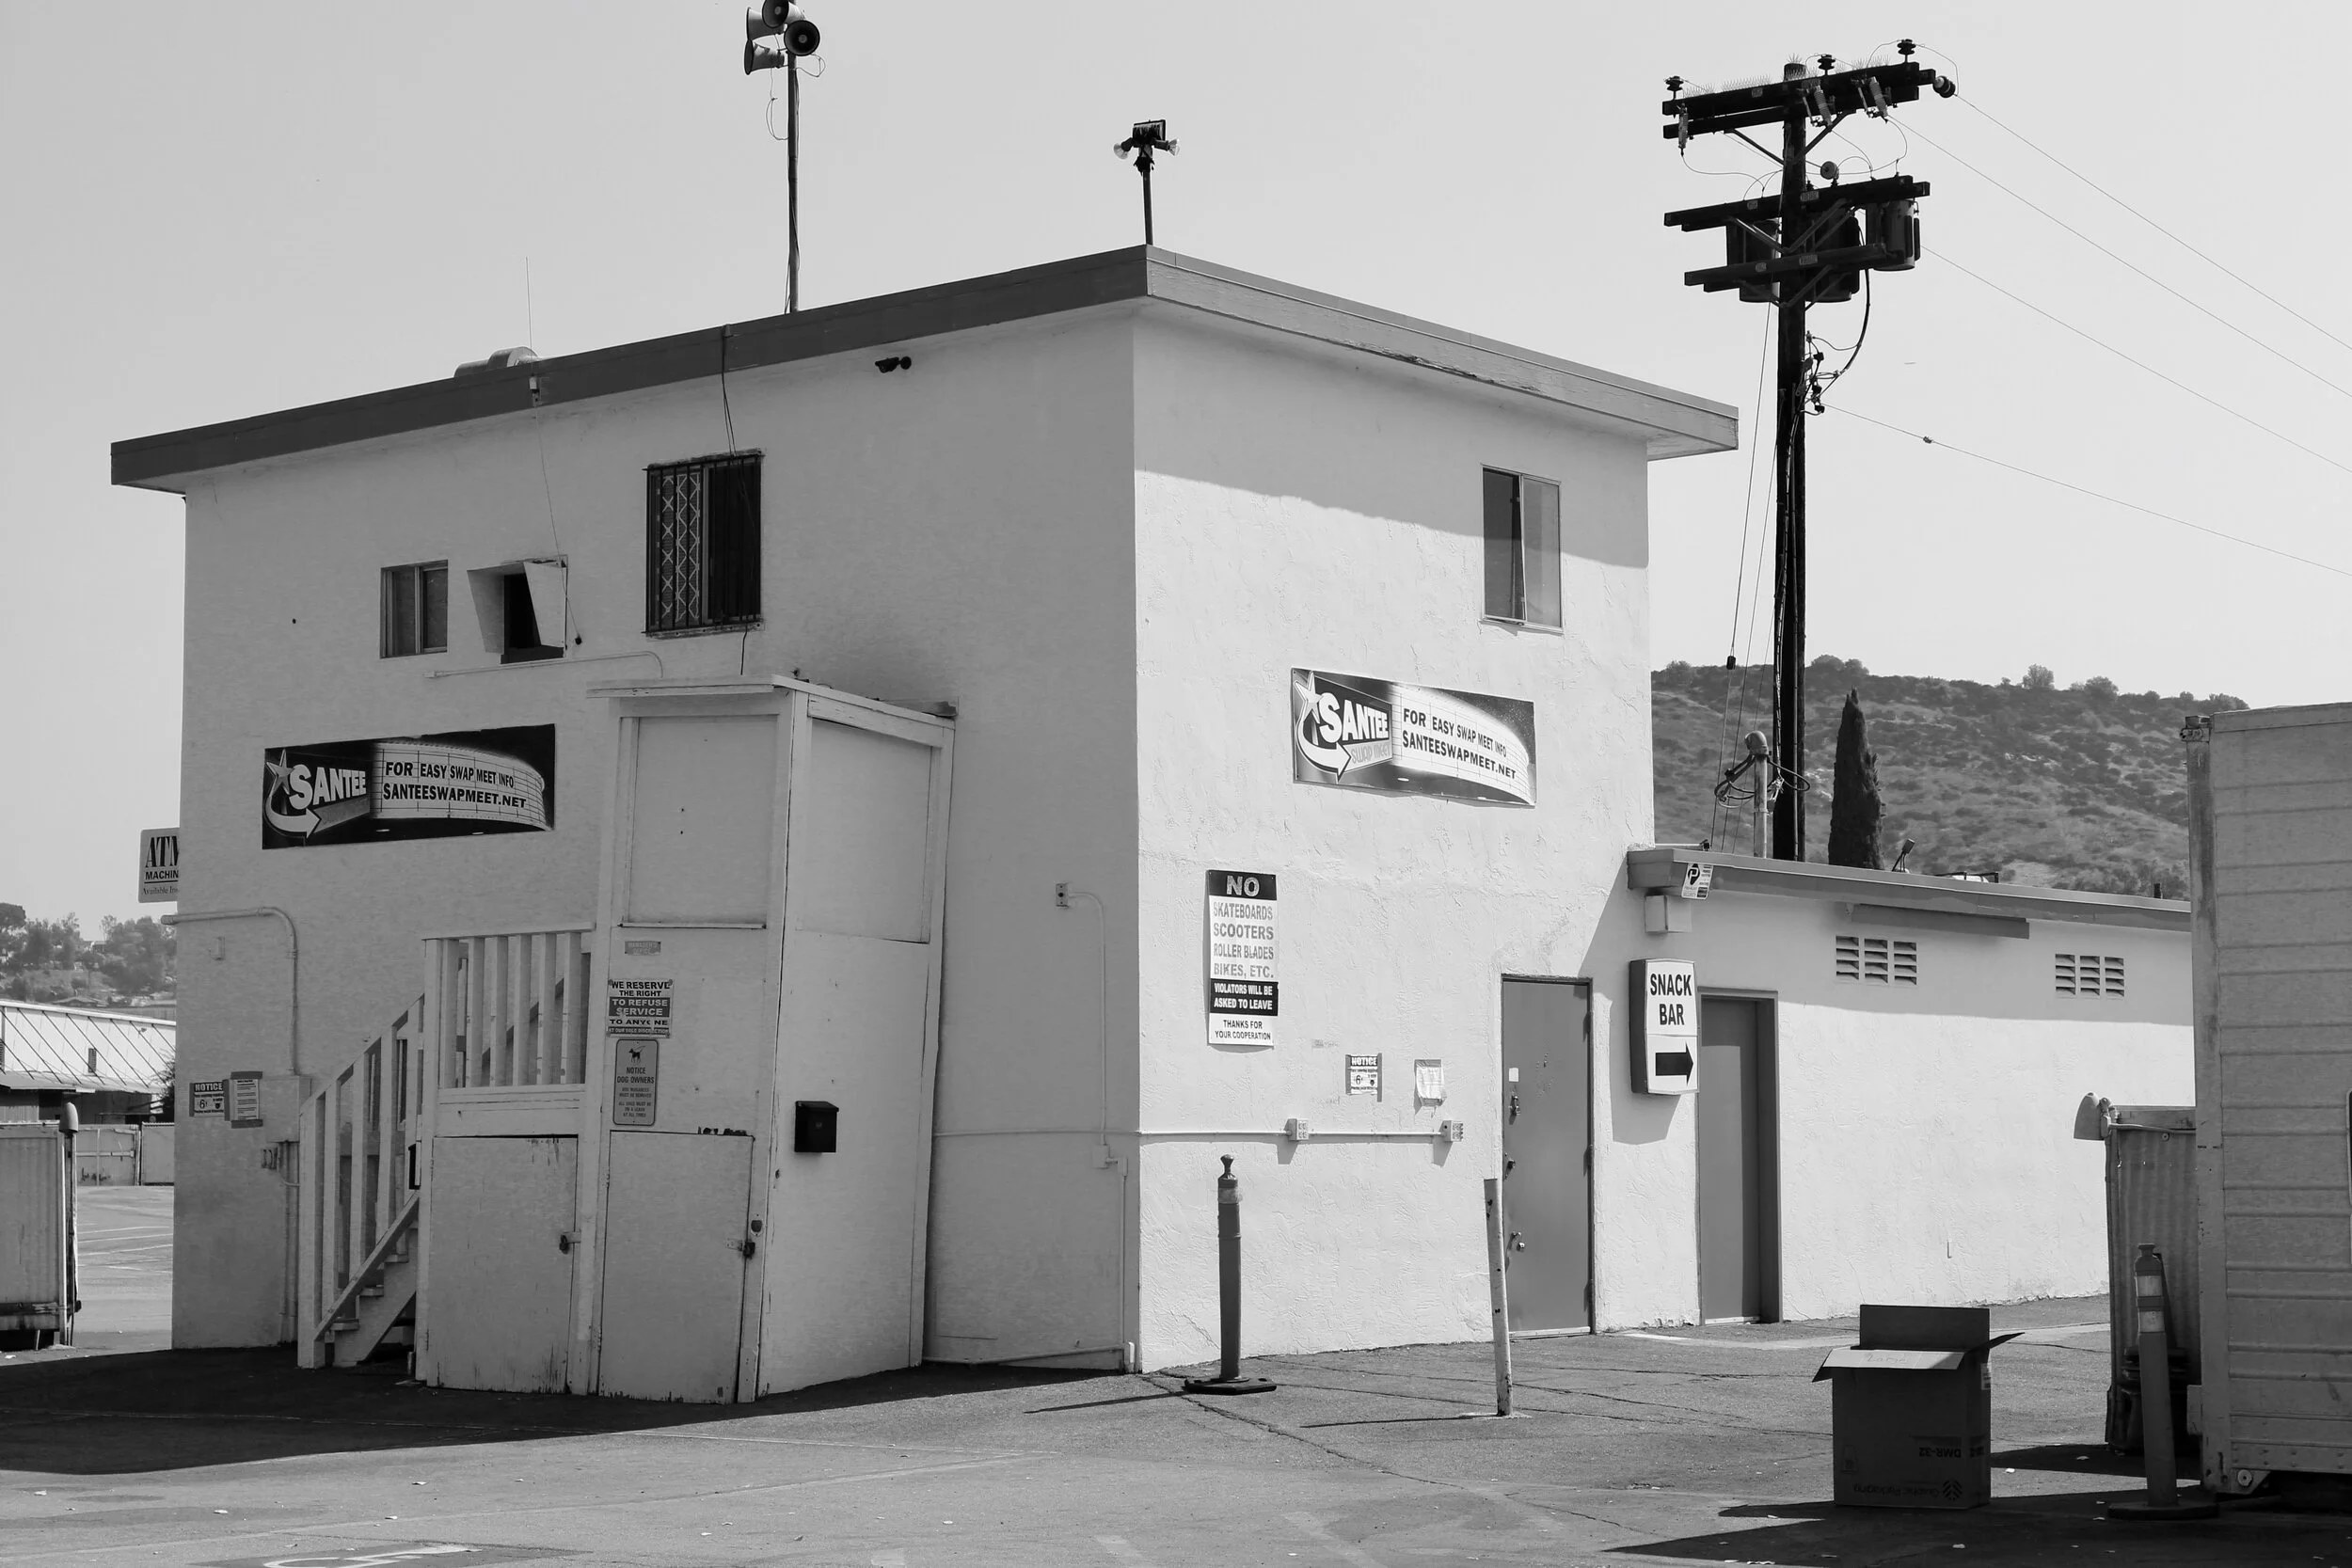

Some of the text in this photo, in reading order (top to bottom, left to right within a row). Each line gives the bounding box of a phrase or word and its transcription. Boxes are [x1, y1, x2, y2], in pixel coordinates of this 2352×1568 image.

[1319, 692, 1389, 743] SANTEE
[1404, 708, 1507, 758] FOR EASY SWAP MEET INFO
[1403, 730, 1517, 780] SANTEESWAPMEET.NET
[386, 762, 514, 788] FOR EASY SWAP MEET INFO
[289, 764, 367, 810] SANTEE
[383, 783, 527, 809] SANTEESWAPMEET.NET
[1227, 875, 1260, 896] NO
[1214, 902, 1273, 920] SKATEBOARDS
[1214, 923, 1274, 940] SCOOTERS
[1214, 943, 1274, 959] ROLLER BLADES
[1214, 963, 1274, 979] BIKES, ETC.
[627, 981, 670, 990] RESERVE
[1214, 982, 1273, 995] VIOLATORS WILL BE
[1650, 974, 1692, 996] SNACK
[615, 1007, 663, 1016] SERVICE
[1214, 997, 1273, 1010] ASKED TO LEAVE
[1660, 1004, 1684, 1025] BAR
[1223, 1020, 1263, 1029] THANKS FOR
[1232, 1031, 1271, 1040] COOPERATION
[1352, 1057, 1377, 1066] NOTICE
[195, 1083, 223, 1091] NOTICE
[1919, 1447, 1962, 1458] DMR-32
